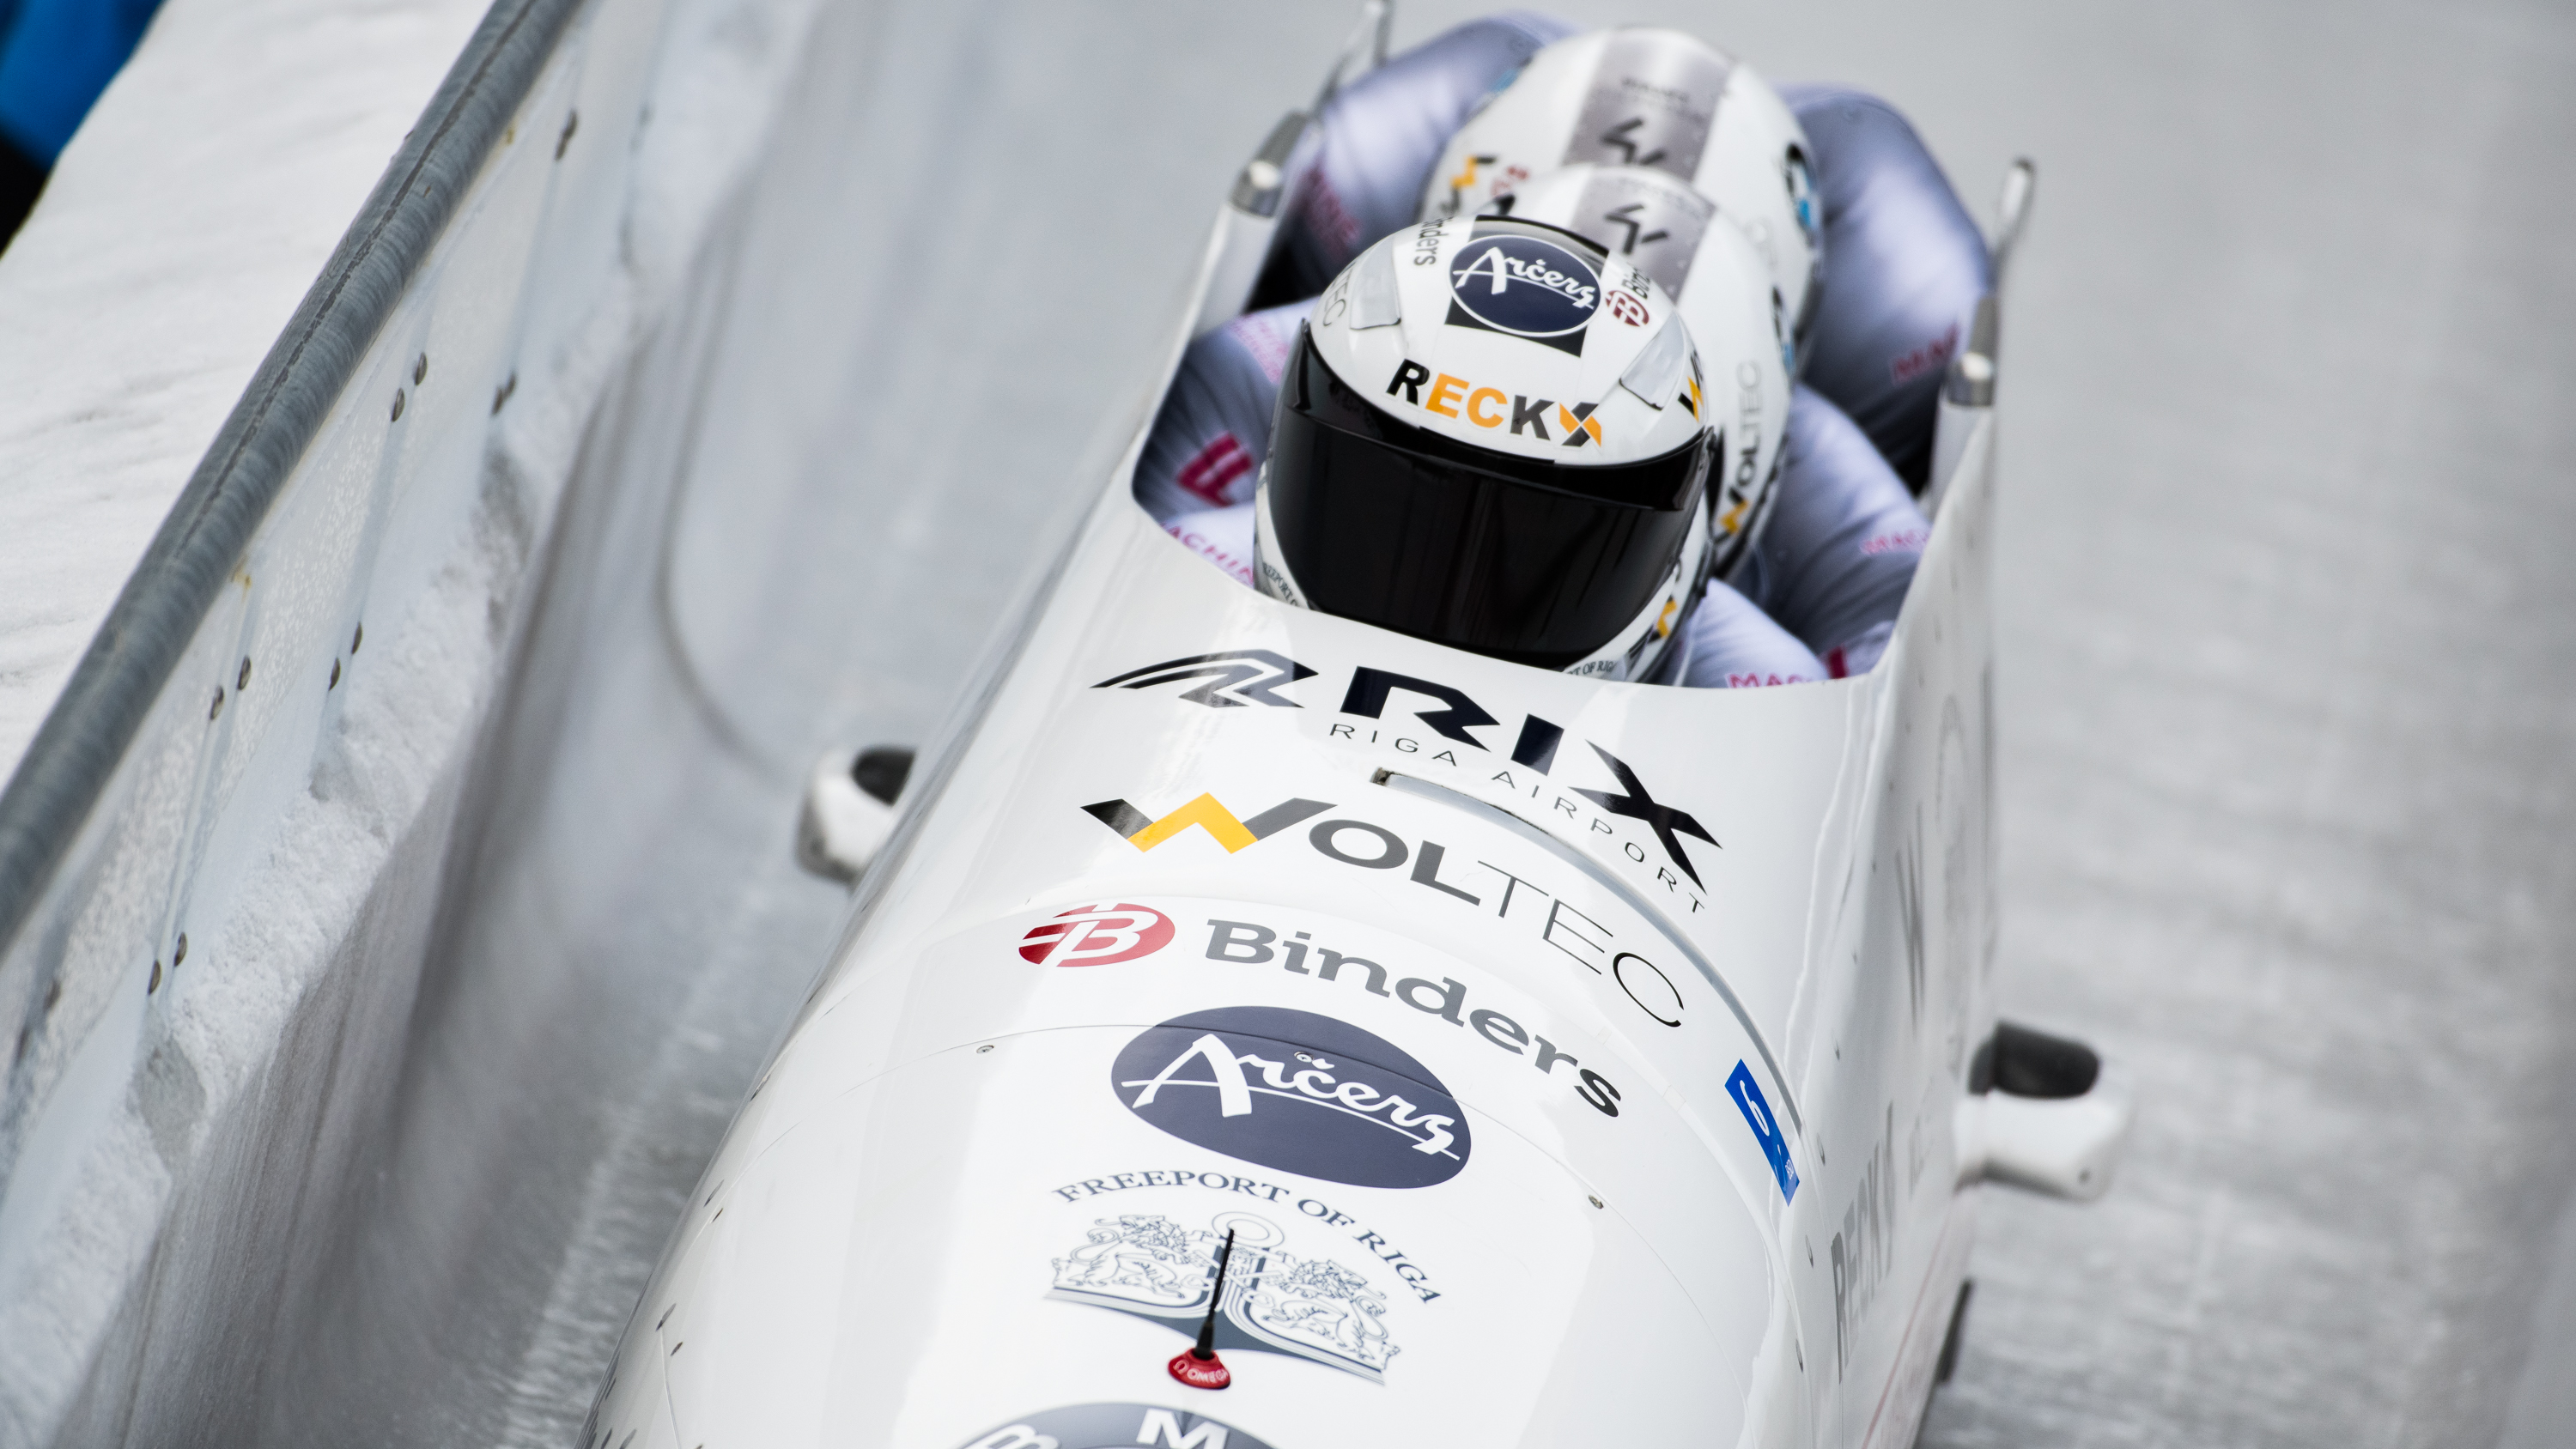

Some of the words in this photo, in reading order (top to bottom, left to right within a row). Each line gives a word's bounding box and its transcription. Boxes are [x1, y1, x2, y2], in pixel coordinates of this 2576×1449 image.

[1329, 723, 1458, 767] RIGA
[1491, 770, 1705, 913] AIRPORT
[1340, 666, 1722, 894] RIX
[1080, 791, 1685, 1028] WOLTEC
[1205, 919, 1622, 1118] Binders
[1051, 1170, 1291, 1203] FREEPORT
[1297, 1198, 1356, 1227] OF
[1352, 1228, 1442, 1304] RIGA
